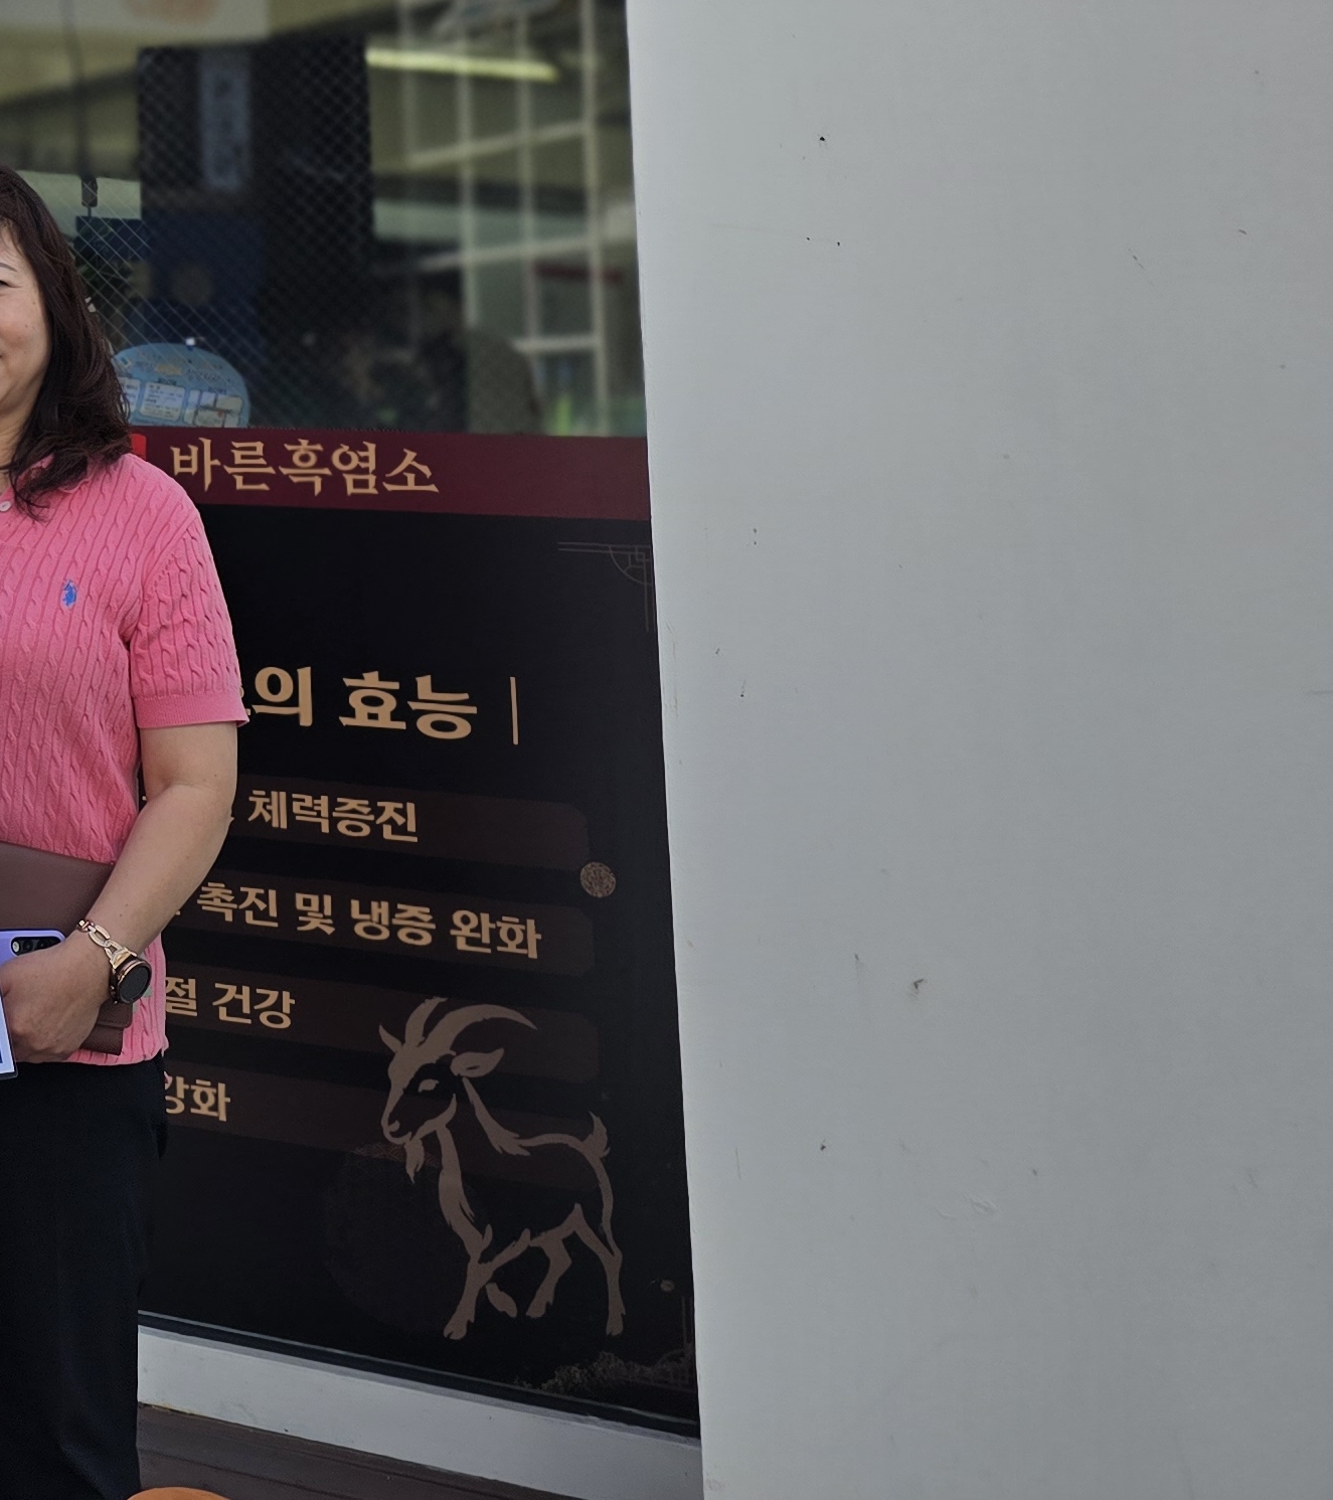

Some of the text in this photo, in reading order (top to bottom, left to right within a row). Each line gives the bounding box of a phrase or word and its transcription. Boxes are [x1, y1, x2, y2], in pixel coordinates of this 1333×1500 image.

[169, 437, 440, 496] 바른흑염소
[239, 665, 478, 740] 의 효능
[248, 787, 420, 843] 체력증진
[197, 881, 542, 959] 촉진 및 냉증 완화
[165, 975, 295, 1030] 절 건강
